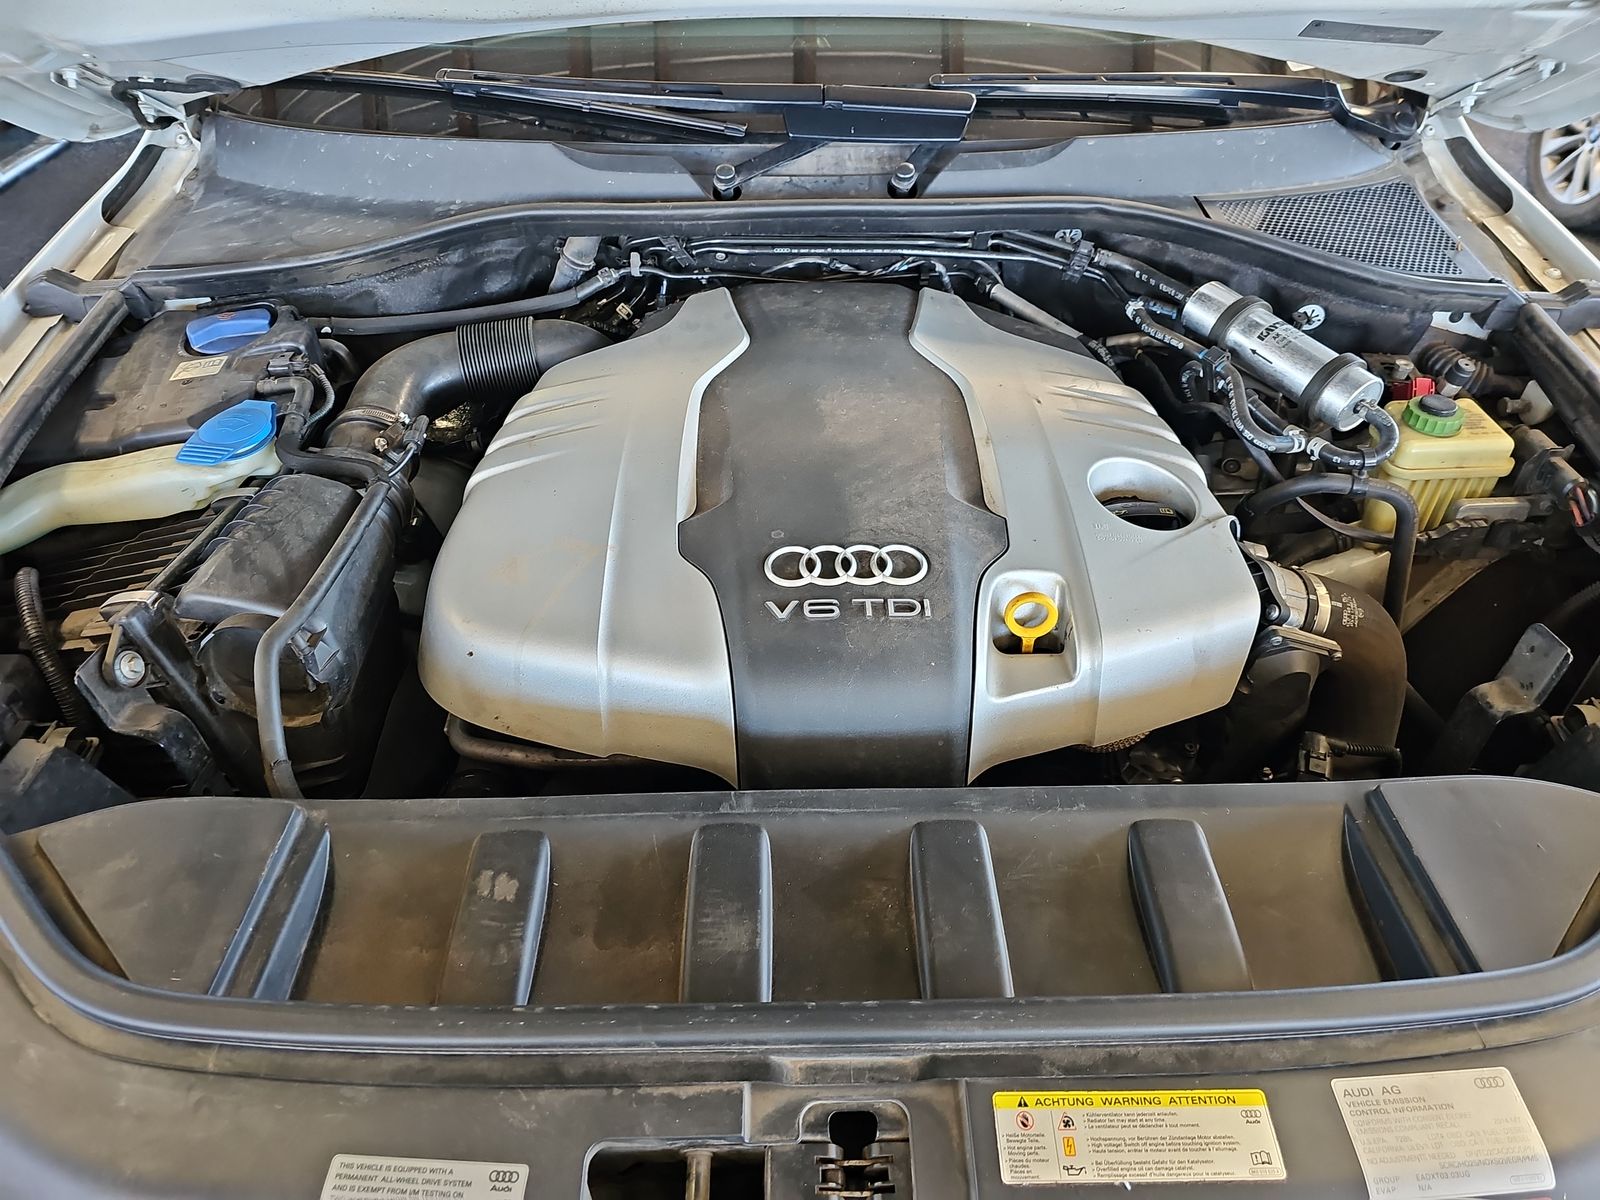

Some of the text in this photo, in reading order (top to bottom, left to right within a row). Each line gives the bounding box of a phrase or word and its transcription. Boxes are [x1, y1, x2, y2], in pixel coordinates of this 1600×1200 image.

[764, 598, 932, 621] V6 TDI
[1343, 1085, 1402, 1098] AUDI AG
[1034, 1096, 1236, 1106] ACHTUNG WARNING ATTENTION
[1346, 1096, 1426, 1108] VEHICLE EMISSION
[1349, 1103, 1454, 1116] CONTROL INFORMATION
[340, 1162, 355, 1170] THIS
[356, 1163, 383, 1171] VEHICLE
[393, 1166, 427, 1174] EQUIPPED
[335, 1173, 379, 1182] PERMANENT
[421, 1178, 441, 1186] DRIVE
[443, 1179, 472, 1187] SYSTEM
[332, 1184, 348, 1192] AND
[356, 1185, 386, 1194] EXEMPT
[386, 1187, 408, 1195] FROM
[421, 1189, 451, 1198] TESTING
